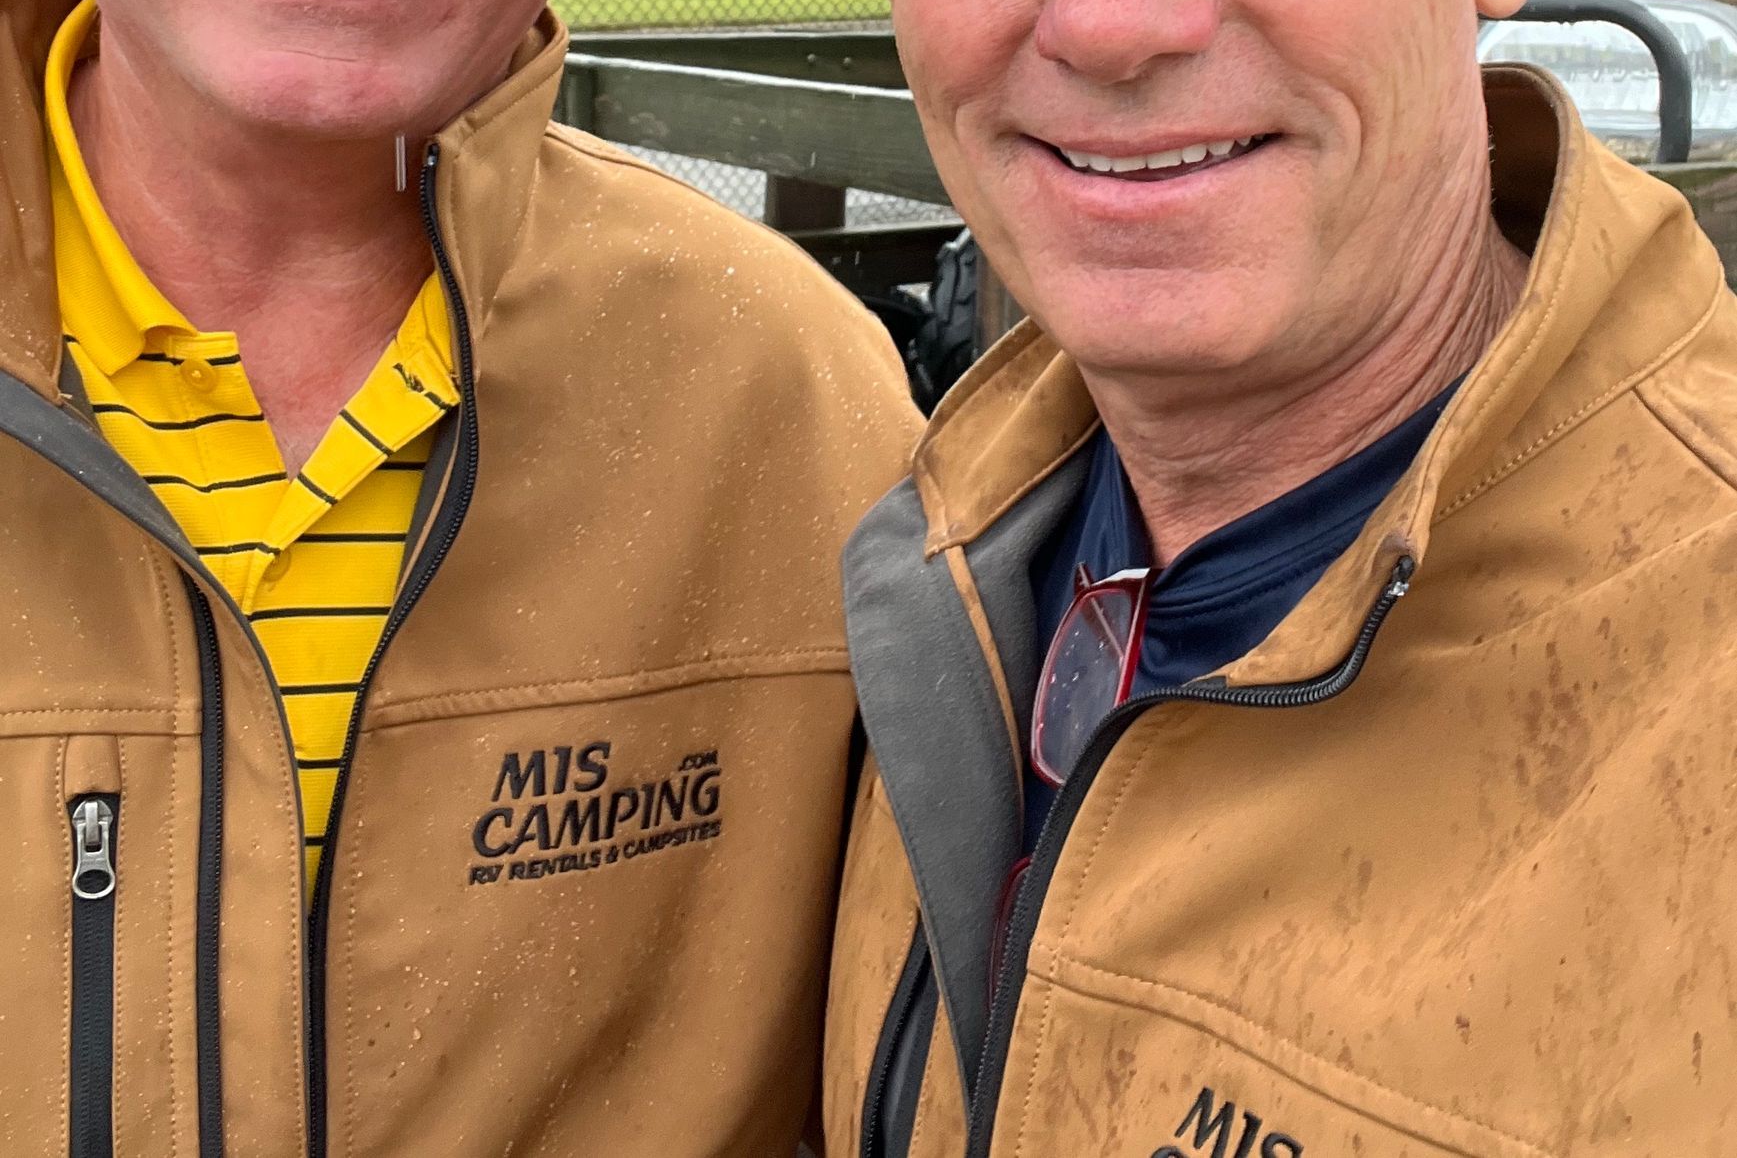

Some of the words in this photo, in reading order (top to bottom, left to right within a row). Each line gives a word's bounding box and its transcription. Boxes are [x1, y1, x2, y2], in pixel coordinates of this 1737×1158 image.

[491, 742, 611, 802] MIS
[472, 768, 721, 858] CAMPING
[469, 864, 504, 885] RV
[508, 848, 601, 881] RENTALS
[605, 845, 619, 864] &
[622, 818, 722, 859] CAMPSITES
